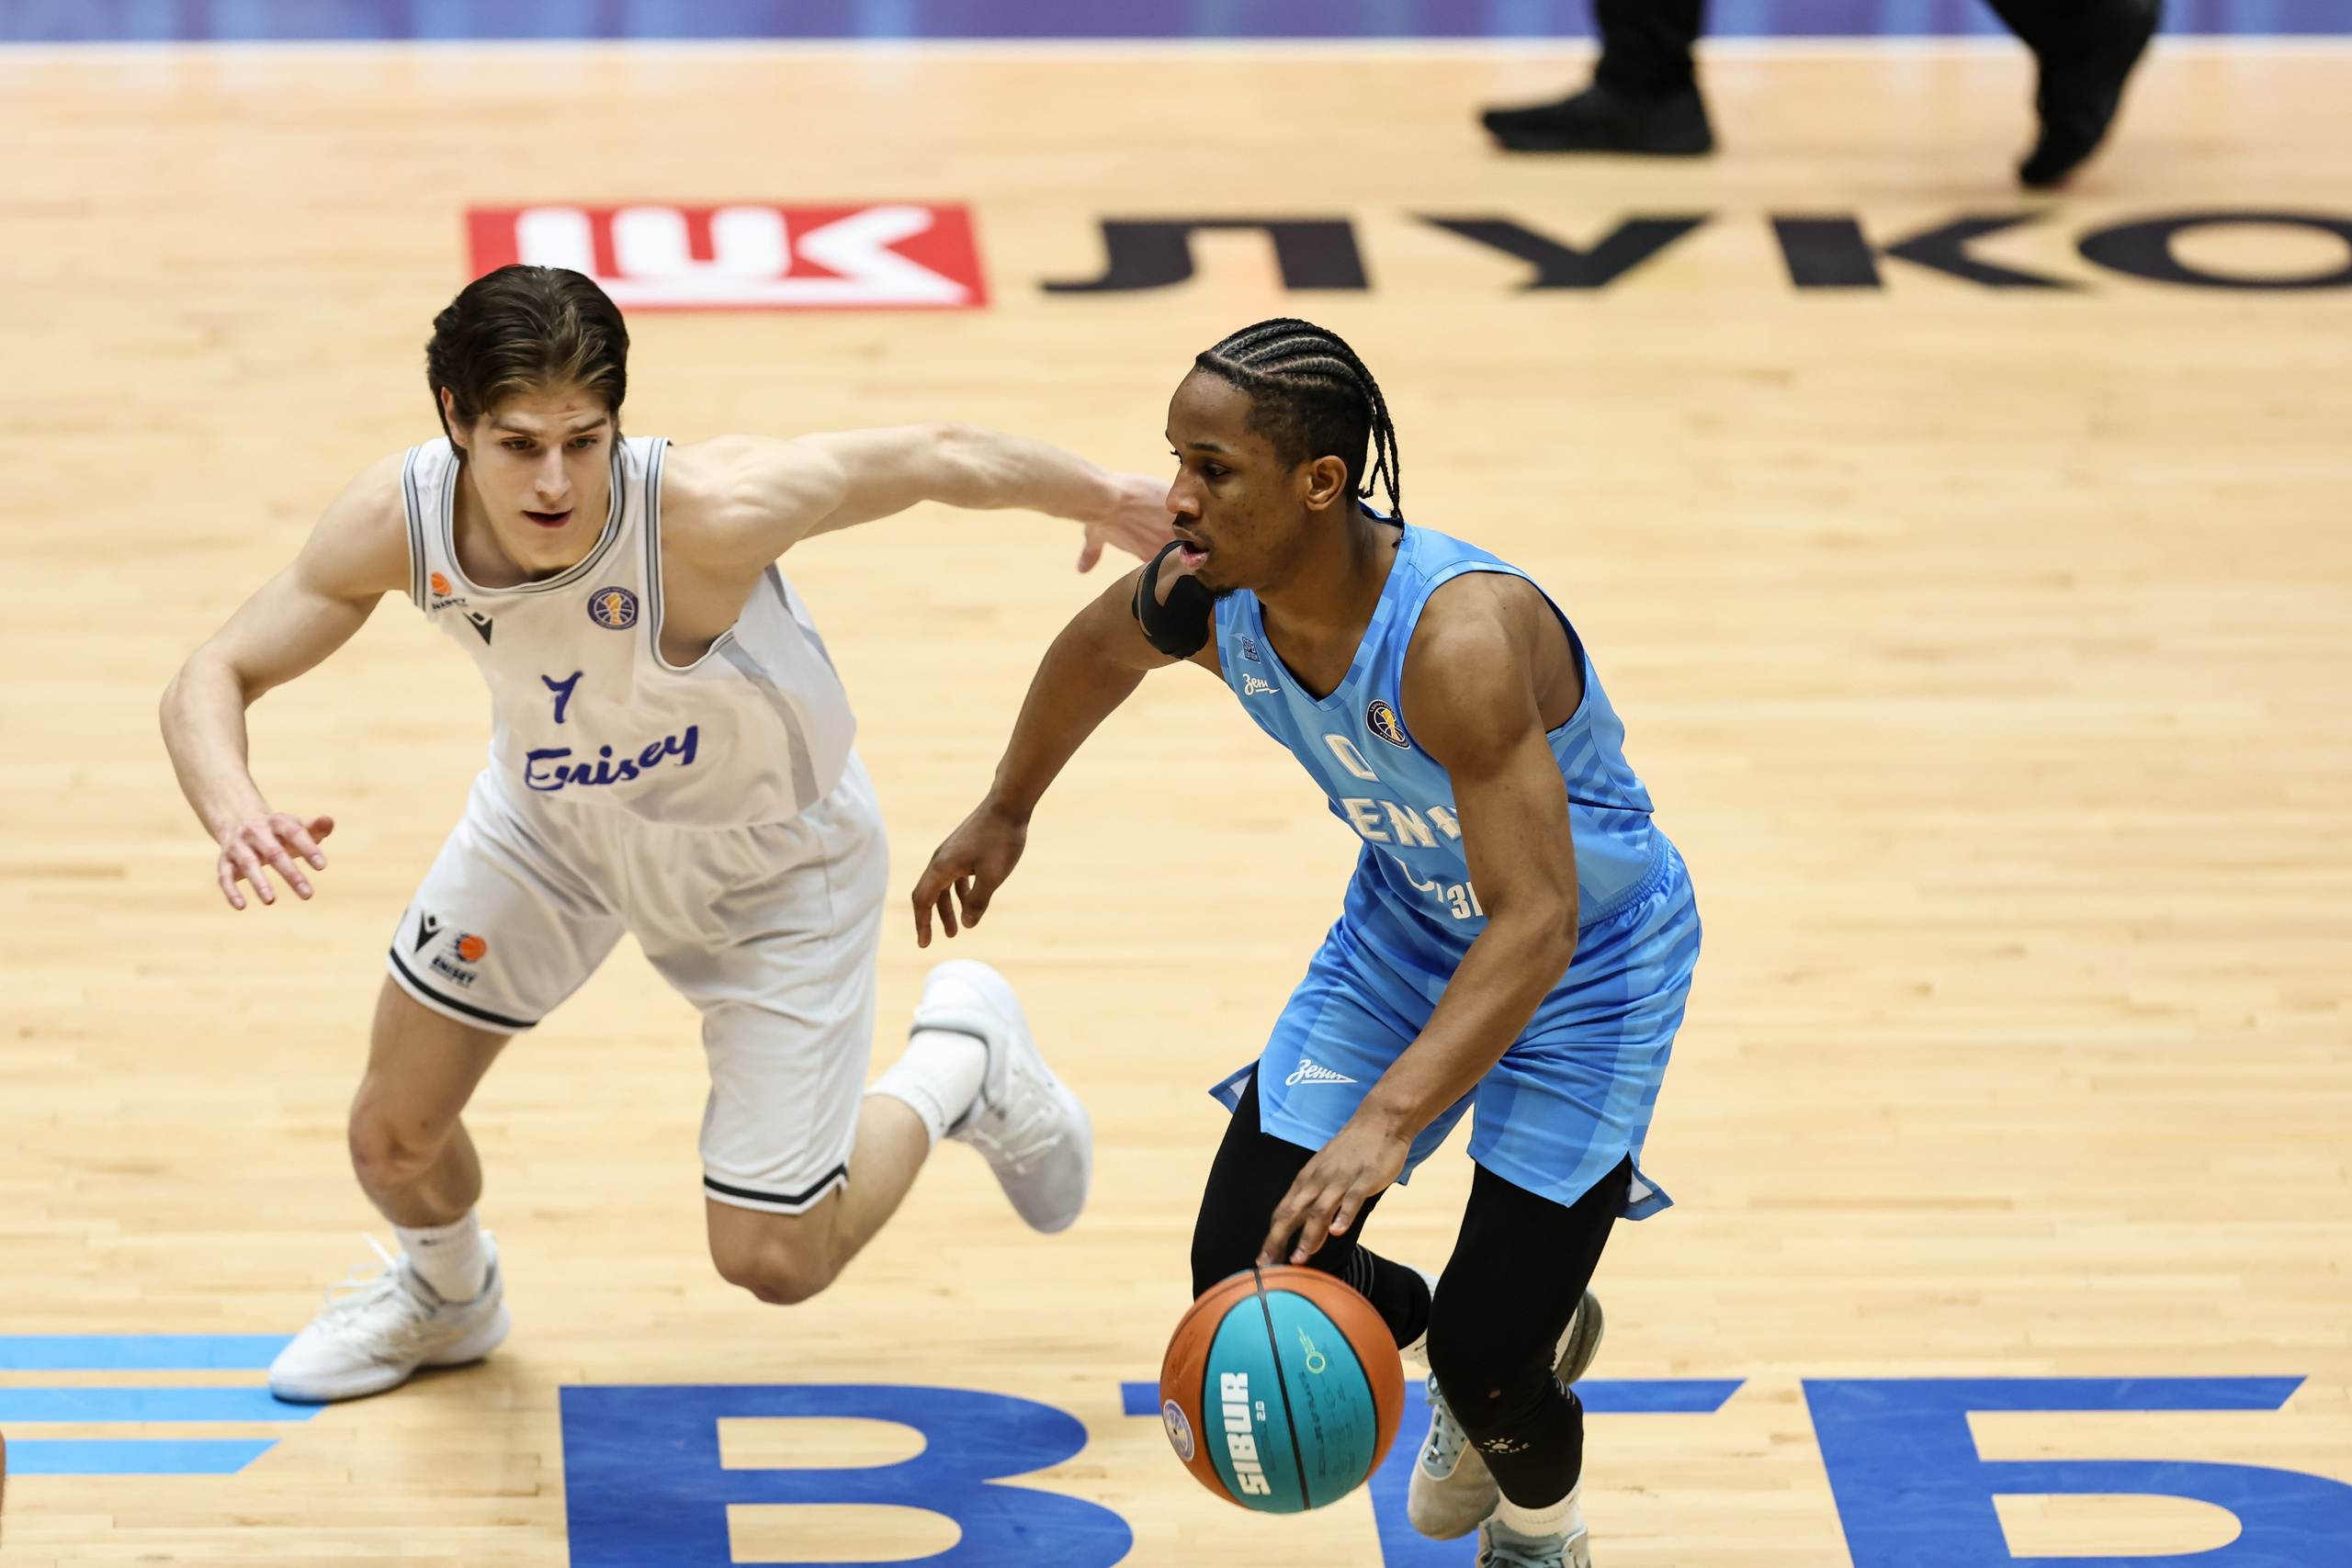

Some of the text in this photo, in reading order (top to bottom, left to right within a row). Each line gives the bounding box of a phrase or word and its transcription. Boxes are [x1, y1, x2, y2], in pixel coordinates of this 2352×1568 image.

[525, 725, 699, 791] Enisey
[1340, 796, 1462, 849] ENI
[1220, 1371, 1272, 1495] SIBUR
